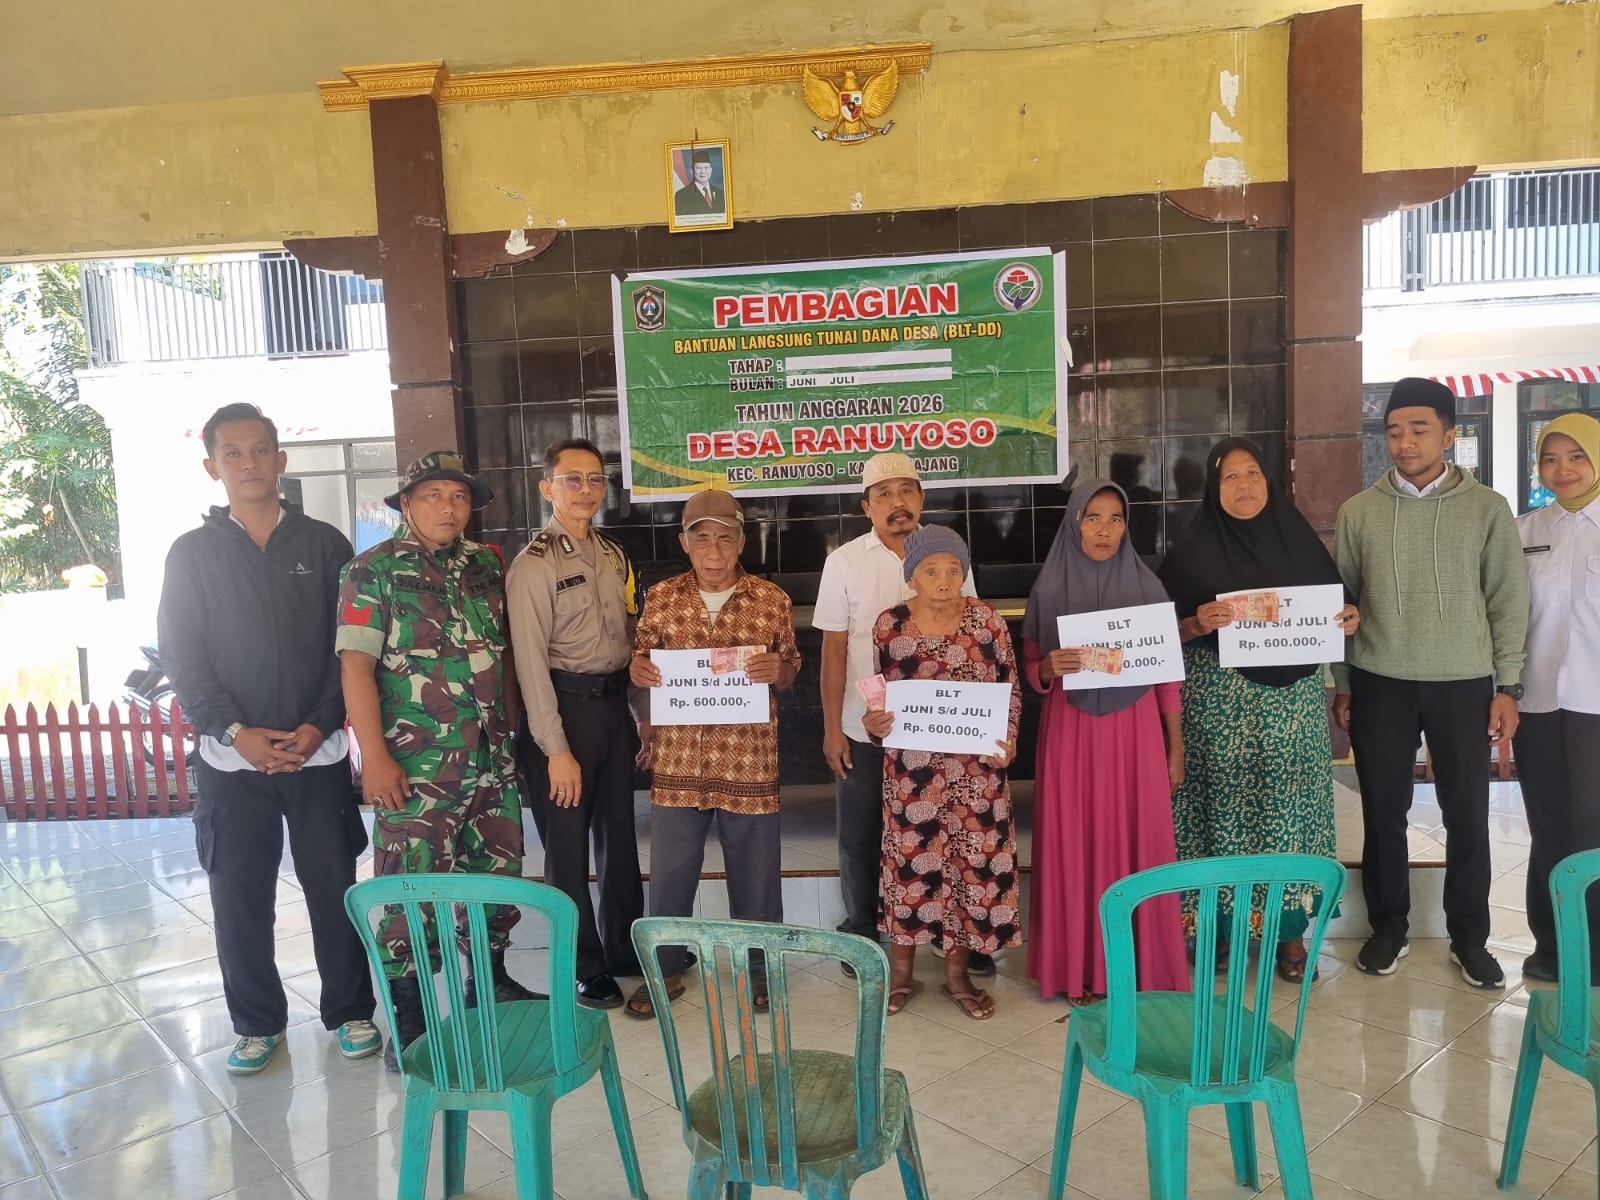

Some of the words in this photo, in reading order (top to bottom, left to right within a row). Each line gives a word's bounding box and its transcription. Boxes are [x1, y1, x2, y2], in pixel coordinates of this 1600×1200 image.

[715, 284, 957, 327] PEMBAGIAN
[674, 337, 736, 354] BANTUAN
[741, 333, 812, 350] LANGSUNG
[817, 330, 857, 345] TUNAI
[862, 328, 899, 343] DANA
[904, 326, 938, 341] DESA
[944, 322, 1002, 341] (BLT-DD)
[729, 359, 773, 374] TAHAP
[730, 377, 774, 392] BULAN
[790, 378, 816, 387] JUNI
[830, 376, 855, 385] JULI
[736, 402, 793, 423] TAHUN
[800, 397, 893, 420] ANGGARAN
[899, 395, 943, 414] 2026
[688, 430, 784, 460] DESA
[793, 419, 996, 454] RANUYOSO
[728, 467, 757, 482] KEC.
[762, 463, 833, 479] RANUYOSO
[849, 462, 865, 475] KA
[911, 457, 958, 472] AJANG
[1278, 598, 1292, 608] LT
[1107, 618, 1131, 631] BLT
[1235, 620, 1266, 630] JUNI
[1272, 618, 1292, 628] S/d
[1296, 616, 1328, 627] JULI
[1114, 640, 1133, 650] S/d
[1137, 635, 1165, 648] JULI
[1239, 640, 1260, 651] Rp.
[1264, 637, 1326, 648] 600.000,-
[697, 659, 712, 668] BL
[1123, 656, 1165, 669] 0.000,-
[666, 678, 697, 688] JUNI
[701, 677, 720, 687] S/d
[935, 689, 961, 698] BLT
[669, 697, 689, 709] Rp.
[694, 696, 751, 708] 600.000,-
[901, 705, 933, 714] JUNI
[938, 706, 957, 715] S/d
[962, 707, 991, 718] JULI
[903, 722, 924, 734] Rp.
[928, 724, 987, 739] 600.000,-
